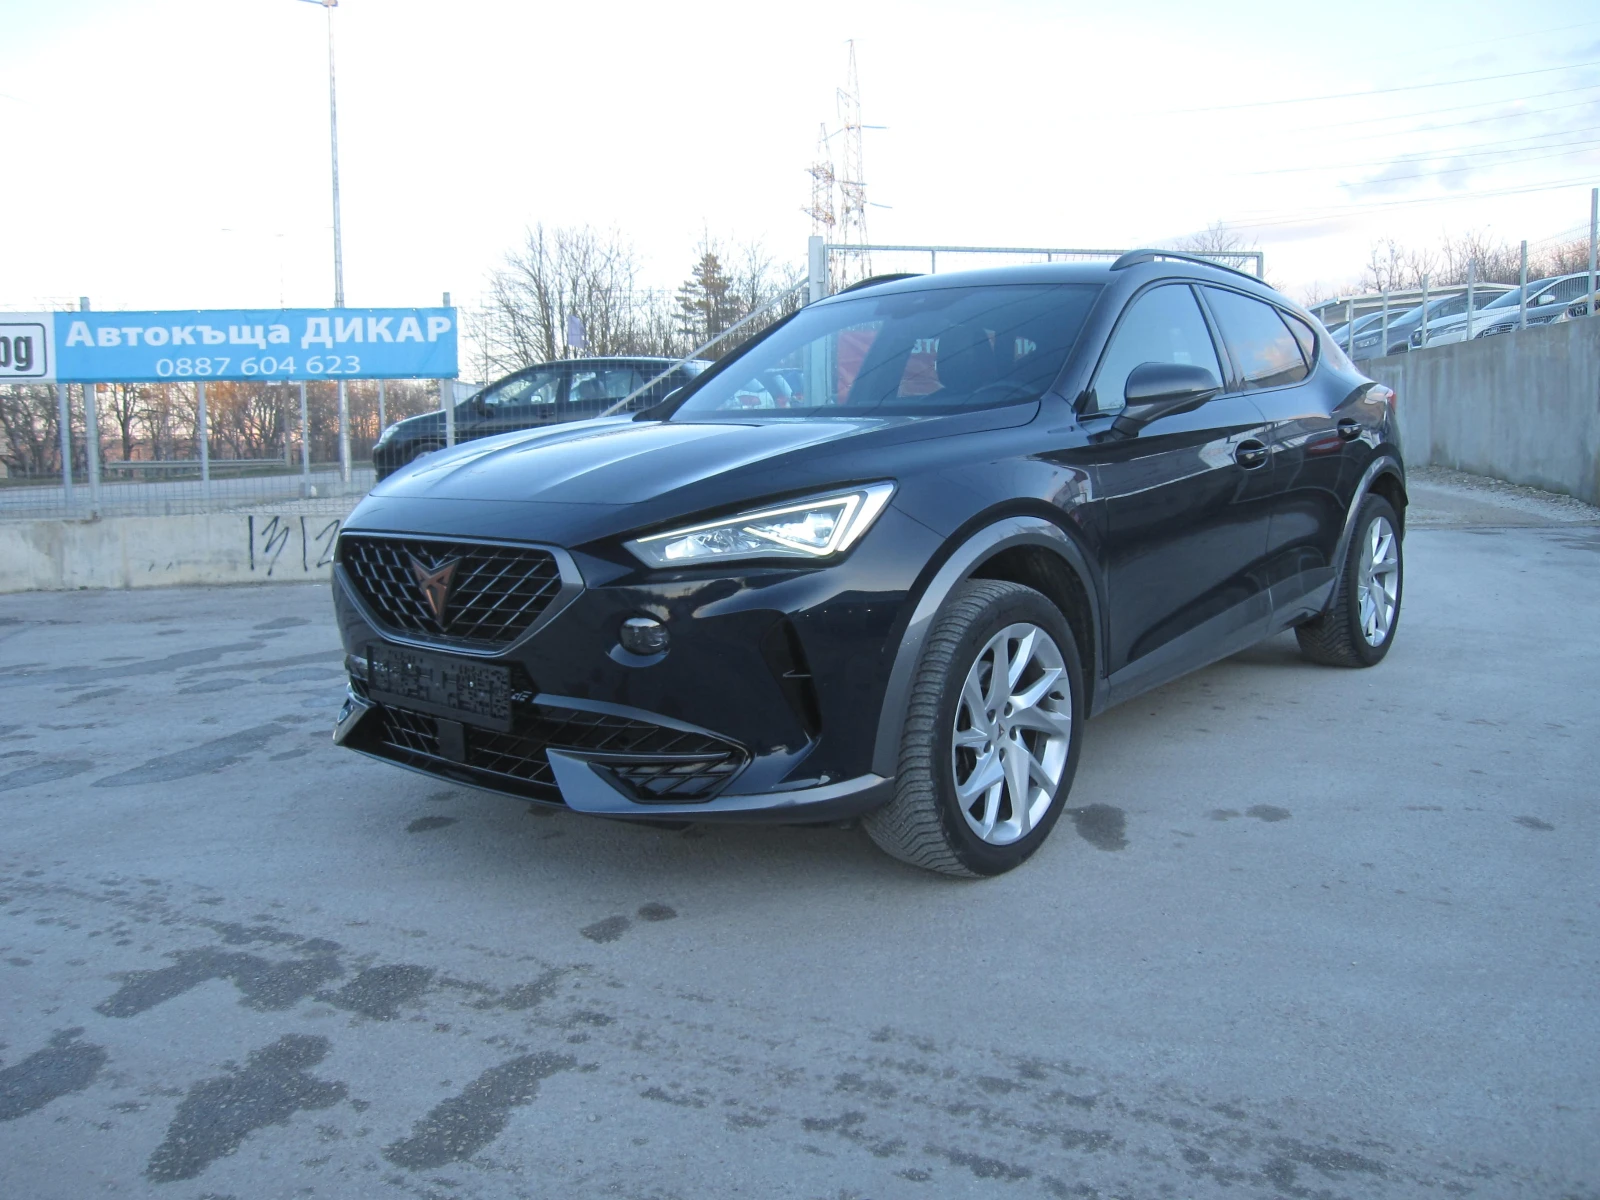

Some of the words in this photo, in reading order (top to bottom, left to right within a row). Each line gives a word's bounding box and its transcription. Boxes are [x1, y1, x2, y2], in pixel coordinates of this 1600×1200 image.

[65, 321, 290, 349] Автокъща
[301, 316, 451, 349] ДИКАР
[156, 357, 231, 377] 0887
[240, 356, 297, 375] 604
[306, 355, 361, 374] 623
